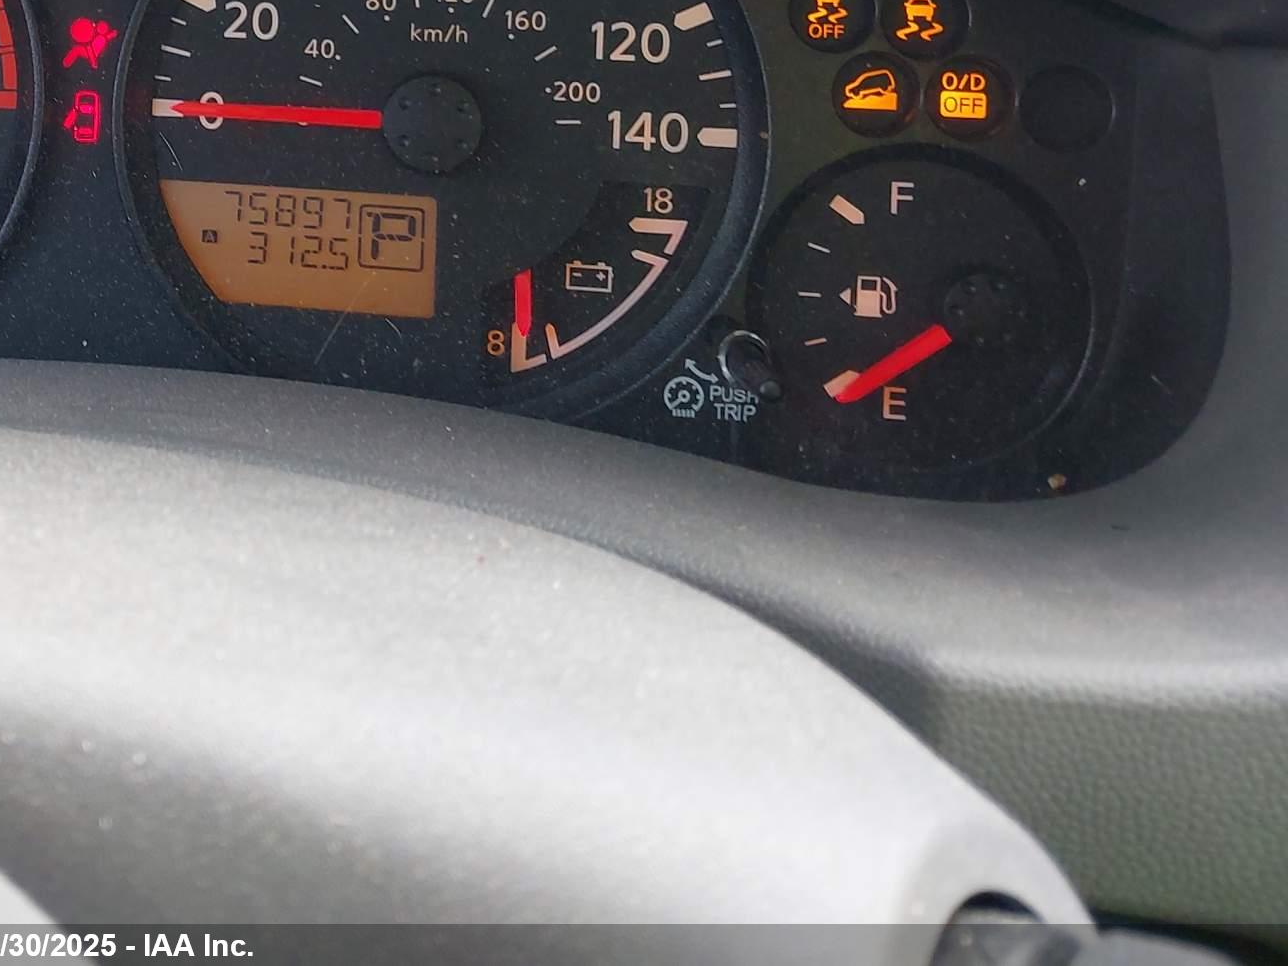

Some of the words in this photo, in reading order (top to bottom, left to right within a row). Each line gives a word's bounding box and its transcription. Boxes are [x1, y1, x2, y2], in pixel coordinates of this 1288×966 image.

[223, 1, 280, 40] 20
[505, 10, 547, 31] 160
[808, 24, 845, 40] OFF
[409, 22, 469, 45] km/h
[591, 21, 672, 63] 120
[304, 38, 335, 60] 40
[553, 82, 601, 104] 200
[941, 71, 986, 91] O/D
[198, 91, 223, 129] 0
[944, 96, 983, 115] OFF
[607, 111, 689, 153] 140
[225, 191, 351, 230] 75897
[643, 187, 673, 212] 18
[890, 182, 915, 215] F
[366, 211, 417, 260] P
[487, 329, 505, 356] 8
[709, 385, 759, 405] PUSH
[882, 386, 907, 421] E
[714, 403, 756, 422] TRIP
